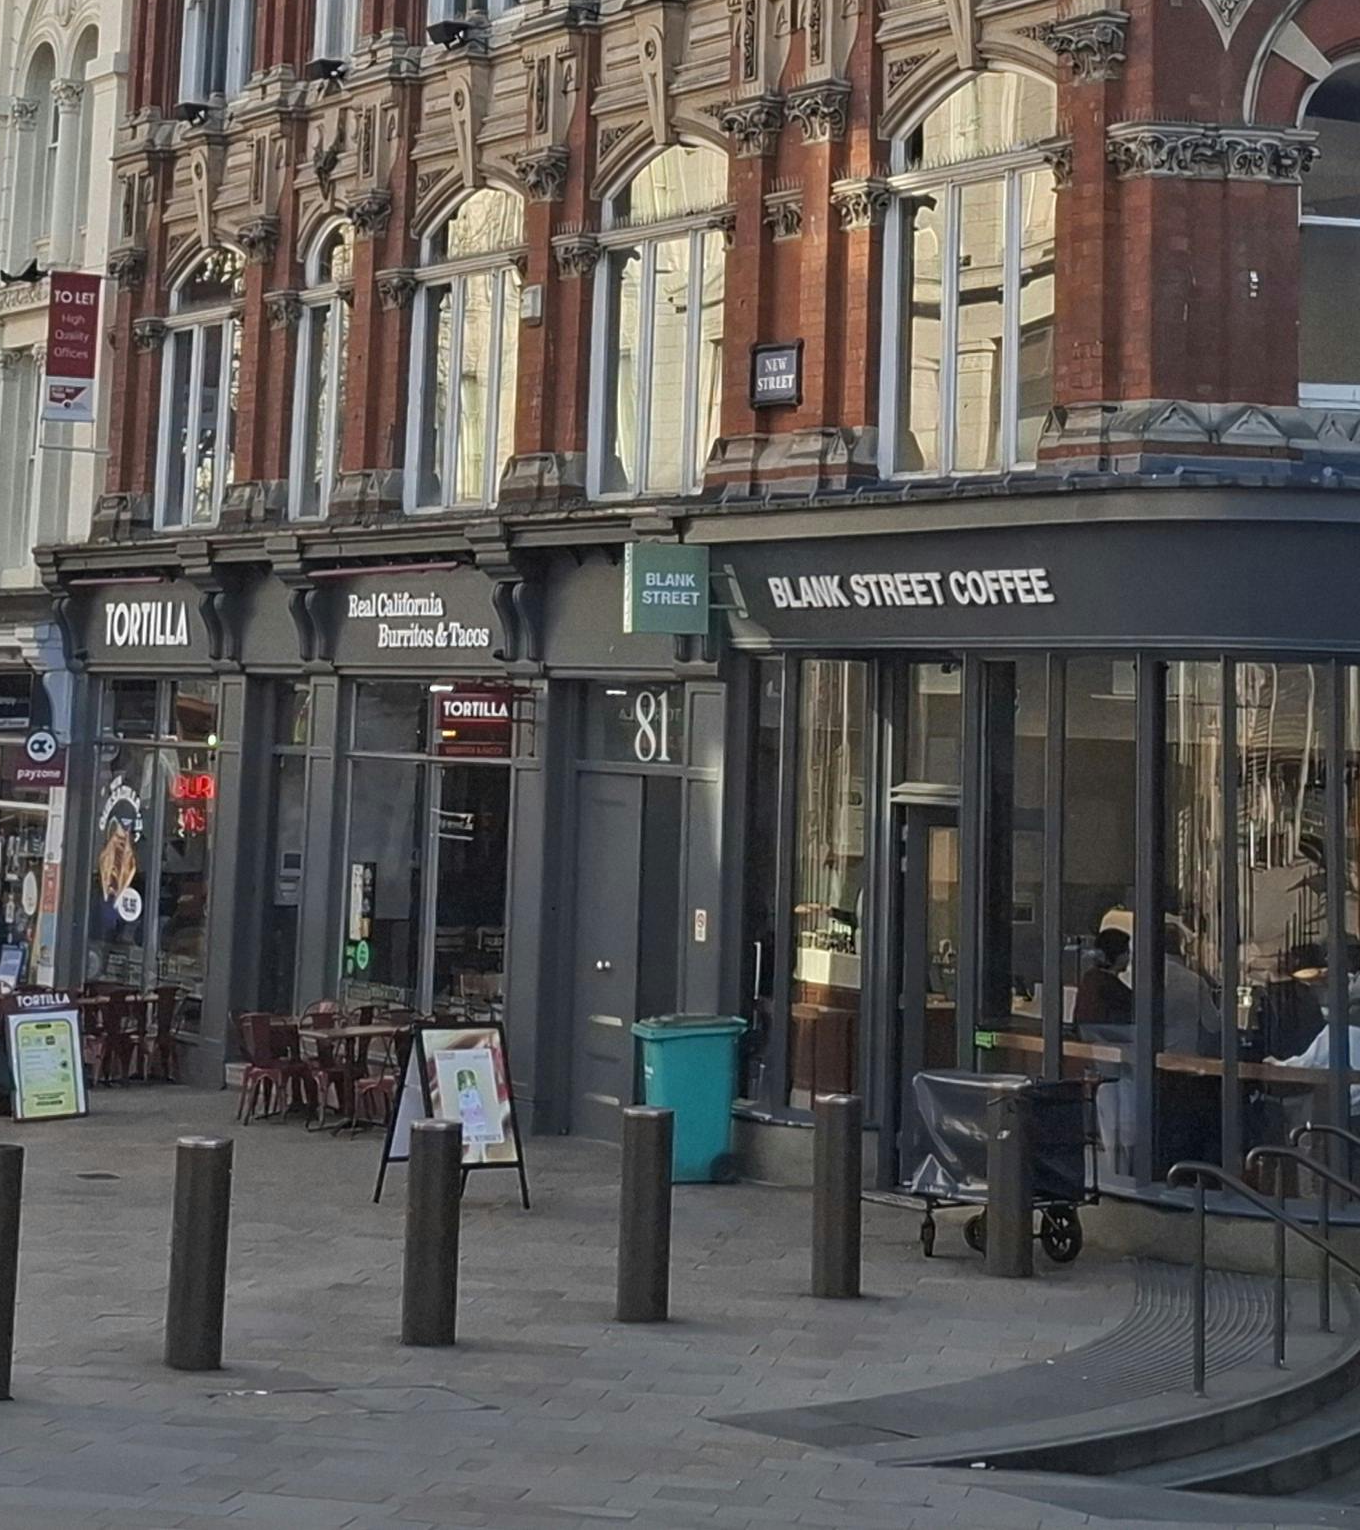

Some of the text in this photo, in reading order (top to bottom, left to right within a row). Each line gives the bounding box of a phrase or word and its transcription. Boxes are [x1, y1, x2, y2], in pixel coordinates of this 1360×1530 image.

[54, 290, 95, 305] TO LET
[61, 314, 86, 325] High
[55, 328, 90, 344] Quality
[53, 346, 89, 359] Offices
[765, 357, 788, 372] NEW
[757, 374, 795, 391] STREET
[646, 572, 696, 587] BLANK
[768, 568, 1055, 608] BLANK STREET COFFEE
[348, 591, 444, 618] Real California
[642, 591, 700, 606] STREET
[105, 601, 188, 647] TORTILLA
[377, 621, 489, 648] Burritos & Tacos
[443, 700, 508, 717] TORTILLA
[634, 690, 670, 762] 81
[16, 769, 61, 781] payzone
[17, 992, 70, 1007] TORTILLA
